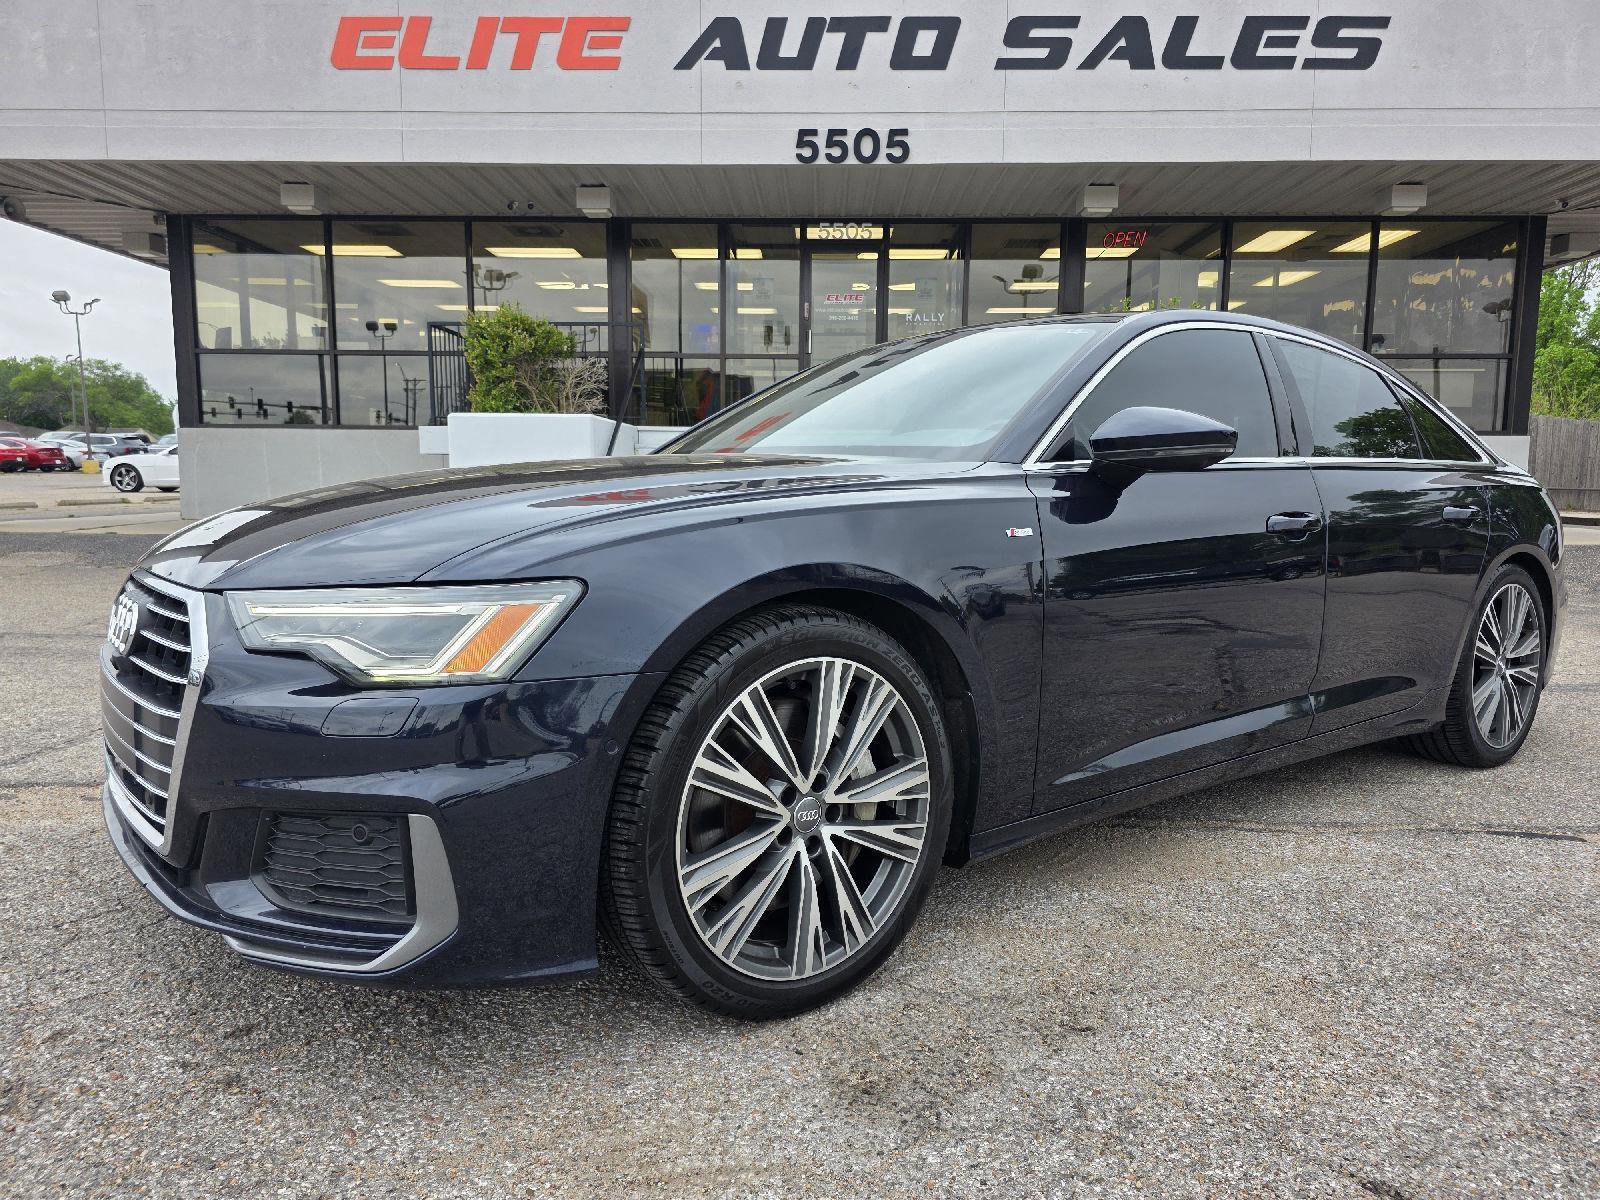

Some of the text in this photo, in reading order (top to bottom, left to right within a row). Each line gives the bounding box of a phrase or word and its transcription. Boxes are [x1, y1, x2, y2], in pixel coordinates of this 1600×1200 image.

[330, 15, 1392, 71] ELITE AUTO SALES
[795, 128, 911, 164] 5505
[818, 222, 873, 239] 5505
[1103, 230, 1149, 248] OPEN
[826, 294, 864, 302] ELITE
[905, 312, 945, 322] RALLY
